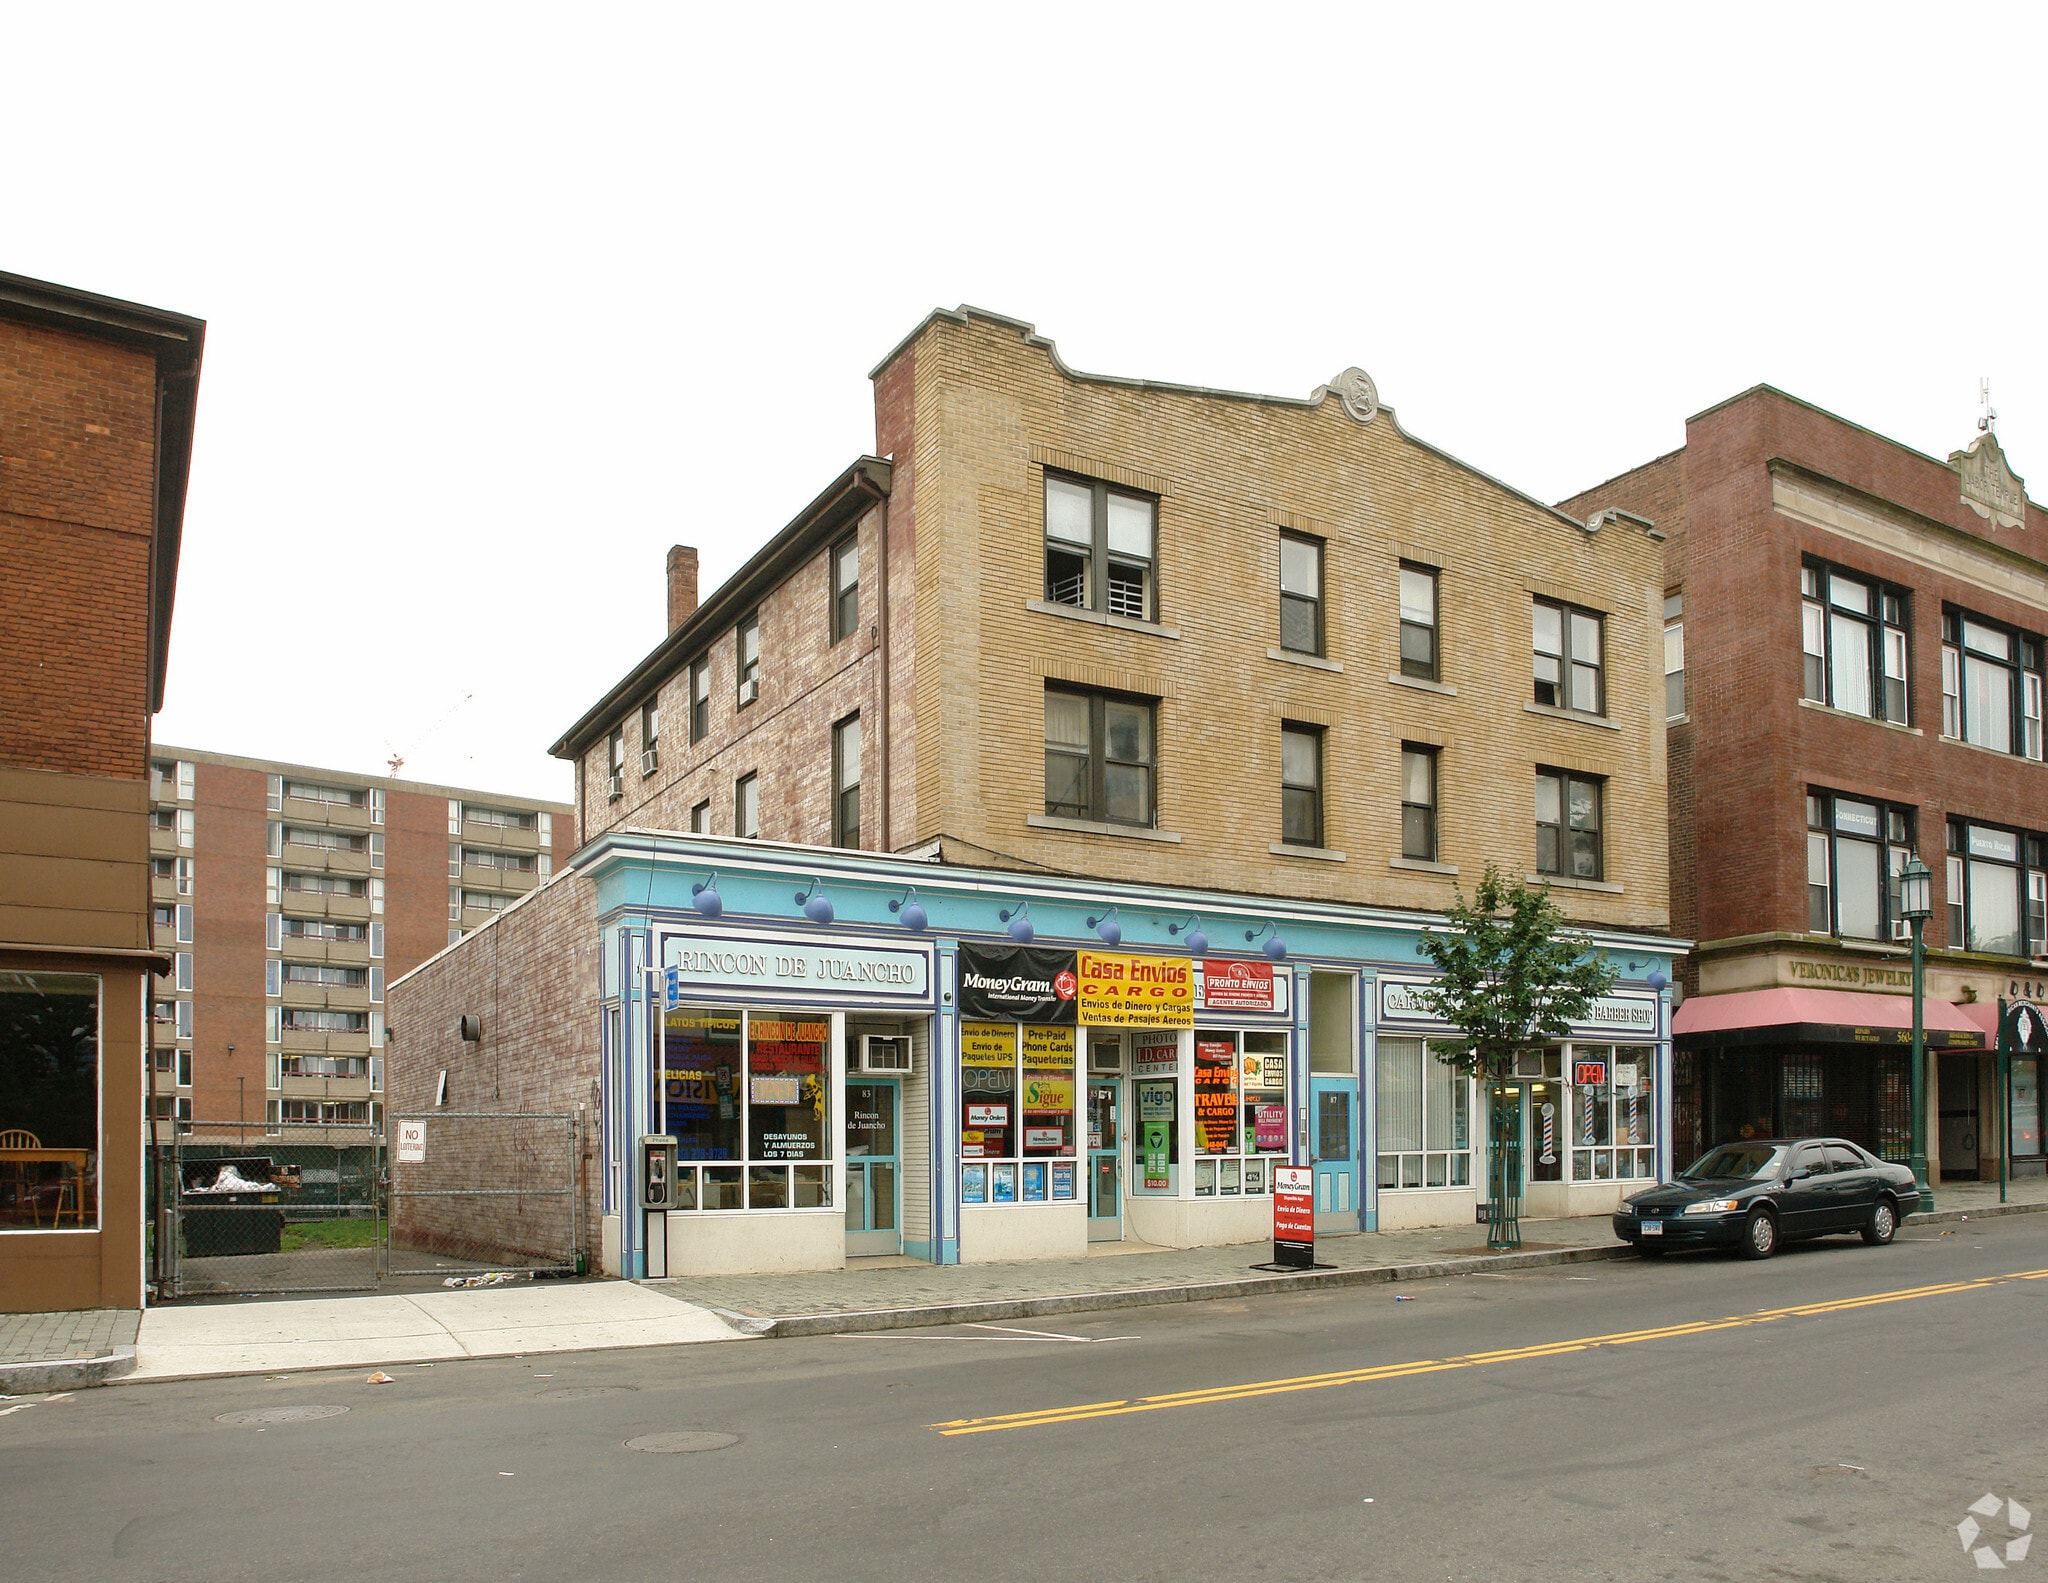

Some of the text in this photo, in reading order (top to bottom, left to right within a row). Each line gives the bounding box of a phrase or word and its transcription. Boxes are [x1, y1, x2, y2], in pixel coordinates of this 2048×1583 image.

[1984, 465, 1998, 482] THE
[1965, 474, 2018, 506] LABOR TEMPLE
[1836, 809, 1877, 825] CONNECTICUT
[678, 950, 916, 983] RINCON DE JUANCHO
[1081, 955, 1187, 984] Casa Envios
[1789, 961, 1912, 987] VERONICA'S JEWELRY
[1209, 979, 1269, 990] PRONTO ENVIOS
[1083, 984, 1187, 997] CARGO
[1081, 999, 1191, 1013] Envios de Dinero y Cargas
[1082, 1012, 1191, 1025] Ventas de Pasajes Aereos
[1595, 1005, 1630, 1022] BARBER
[1631, 1008, 1653, 1023] SHOP
[665, 1018, 696, 1028] LATOS
[749, 1021, 828, 1041] EL RINCON DE JUANCHO
[961, 1028, 980, 1036] Envio
[992, 1029, 1015, 1038] Dinero
[1028, 1030, 1066, 1040] Pre-Paid
[1142, 1033, 1177, 1044] PHOTO
[756, 1042, 820, 1055] RESTAURANTE
[972, 1042, 1003, 1051] Envio de
[1022, 1042, 1073, 1052] Phone Cards
[962, 1052, 1013, 1062] Paquetes UPS
[1138, 1048, 1177, 1062] I.D. CAR
[1264, 1058, 1283, 1069] CASA
[658, 1070, 702, 1080] ELICIAS
[1194, 1067, 1239, 1077] Casa Envios
[1577, 1064, 1603, 1083] OPEN
[963, 1070, 1010, 1088] OPEN
[753, 1080, 796, 1101] OPEN
[862, 1090, 871, 1098] 83
[1027, 1082, 1064, 1107] Sigue
[1141, 1087, 1172, 1106] vigo
[1195, 1093, 1239, 1106] TRAVEL
[854, 1111, 879, 1119] Rincon
[1207, 1108, 1234, 1116] CARGO
[848, 1121, 886, 1129] de Juancho
[405, 1130, 419, 1140] NO
[400, 1143, 424, 1151] LOITERING
[1277, 1182, 1310, 1191] MoneyGram
[1296, 1206, 1311, 1214] Dinero
[1276, 1222, 1287, 1230] Pago
